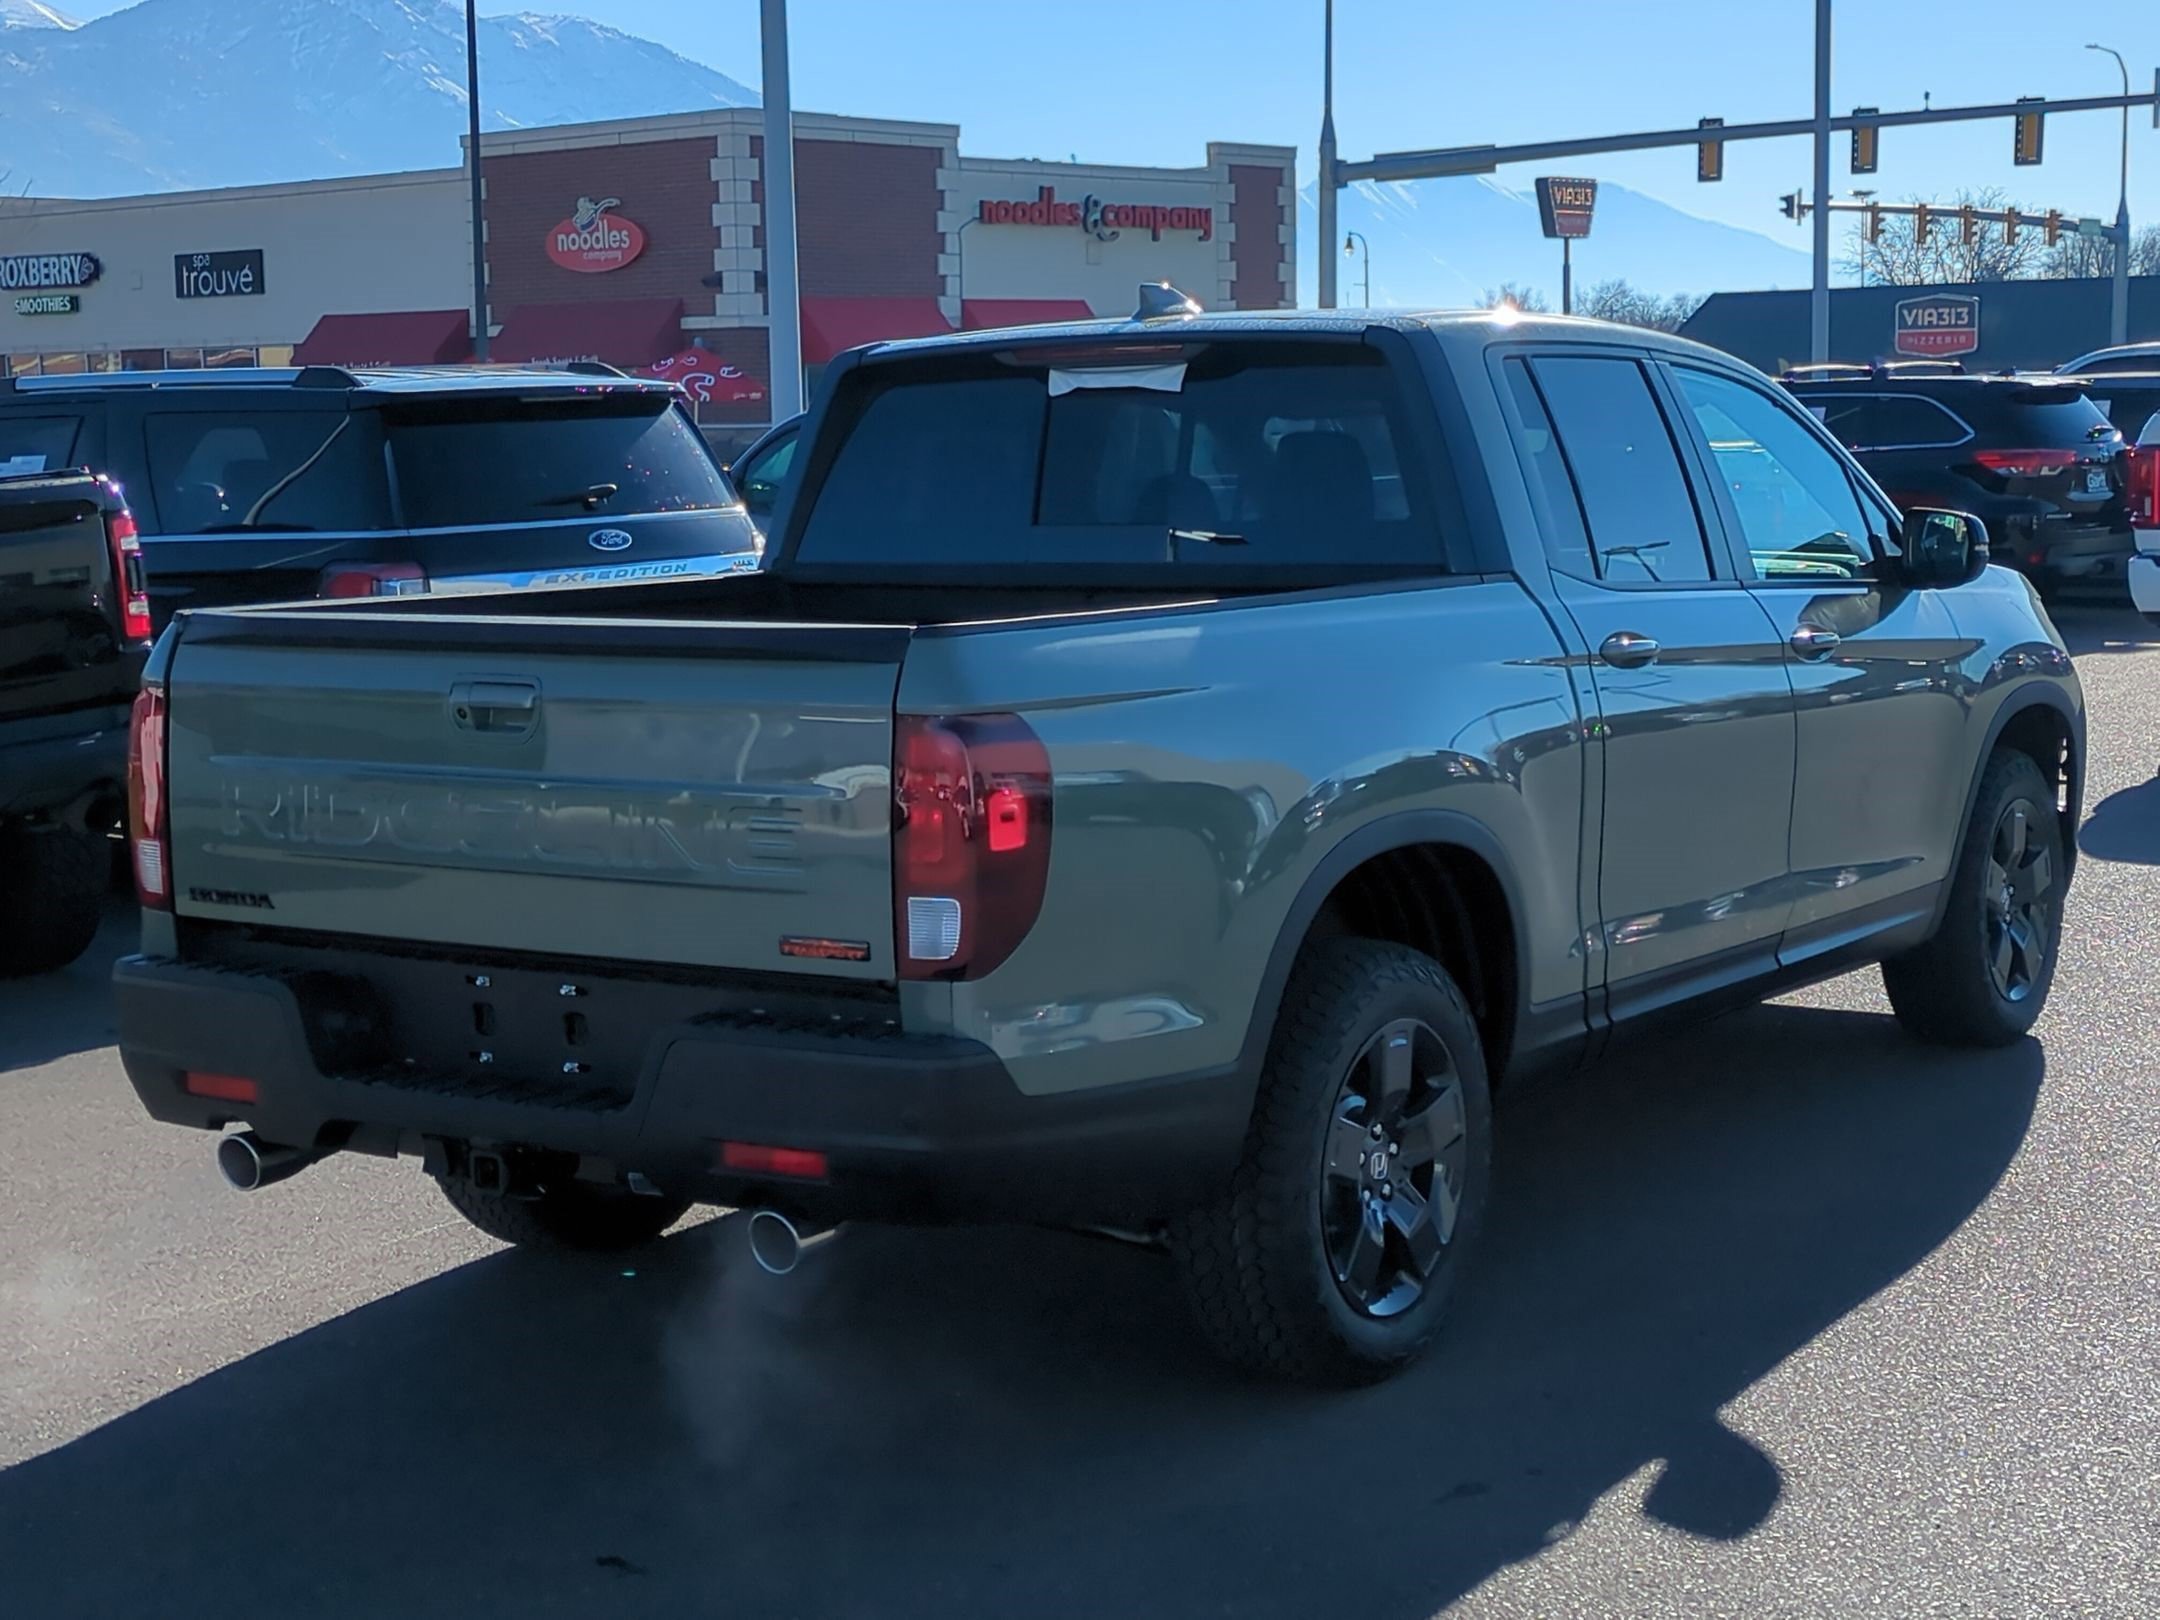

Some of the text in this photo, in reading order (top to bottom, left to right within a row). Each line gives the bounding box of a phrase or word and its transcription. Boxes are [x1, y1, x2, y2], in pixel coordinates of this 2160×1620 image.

[980, 186, 1081, 225] noodles
[1101, 203, 1212, 242] company
[557, 218, 630, 252] noodles
[0, 255, 81, 287] ROXBERRY
[192, 254, 211, 271] spa
[183, 264, 253, 296] trouvé
[15, 296, 71, 313] SMOOTHIES
[1902, 306, 1969, 326] VIA313
[600, 531, 624, 545] Ford
[544, 562, 688, 585] EXPEDITION
[188, 887, 276, 910] HONDA
